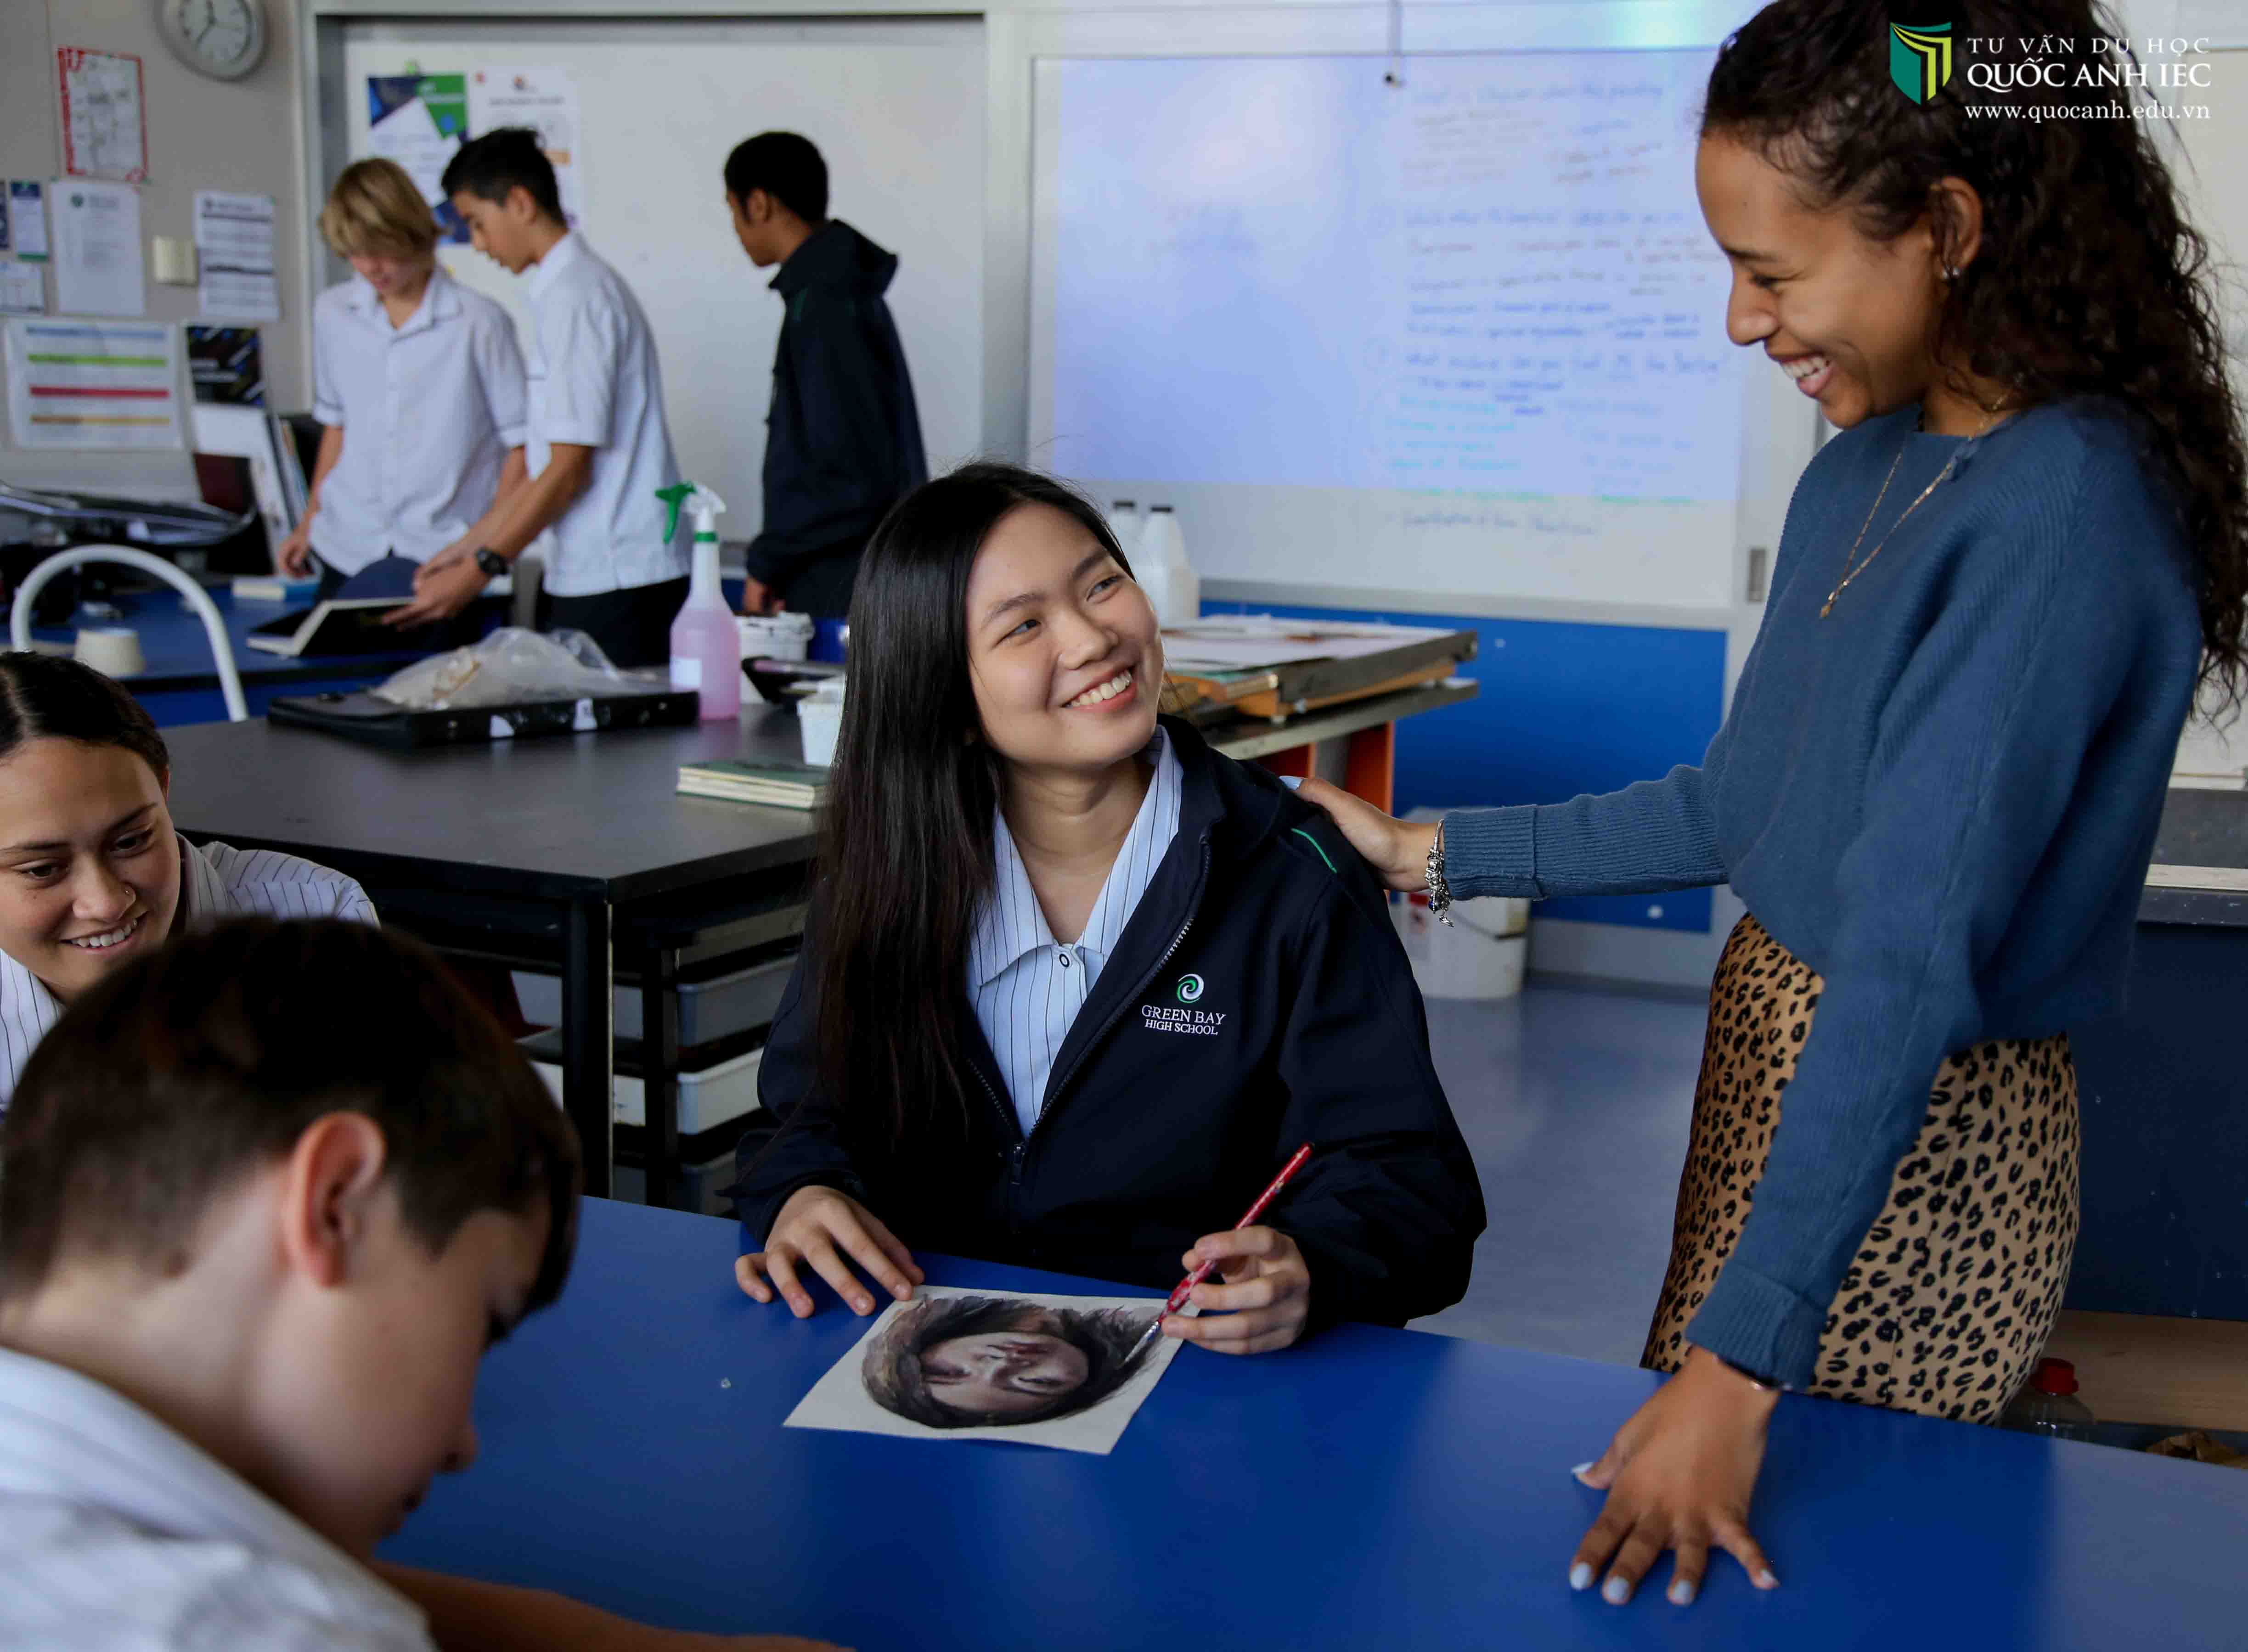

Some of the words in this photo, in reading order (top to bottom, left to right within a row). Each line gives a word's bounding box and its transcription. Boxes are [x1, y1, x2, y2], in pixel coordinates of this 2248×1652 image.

[1142, 1005, 1192, 1023] GREEN
[1194, 1011, 1227, 1025] BAY
[1145, 1019, 1172, 1031] HIGH
[1174, 1023, 1218, 1035] SCHOOL
